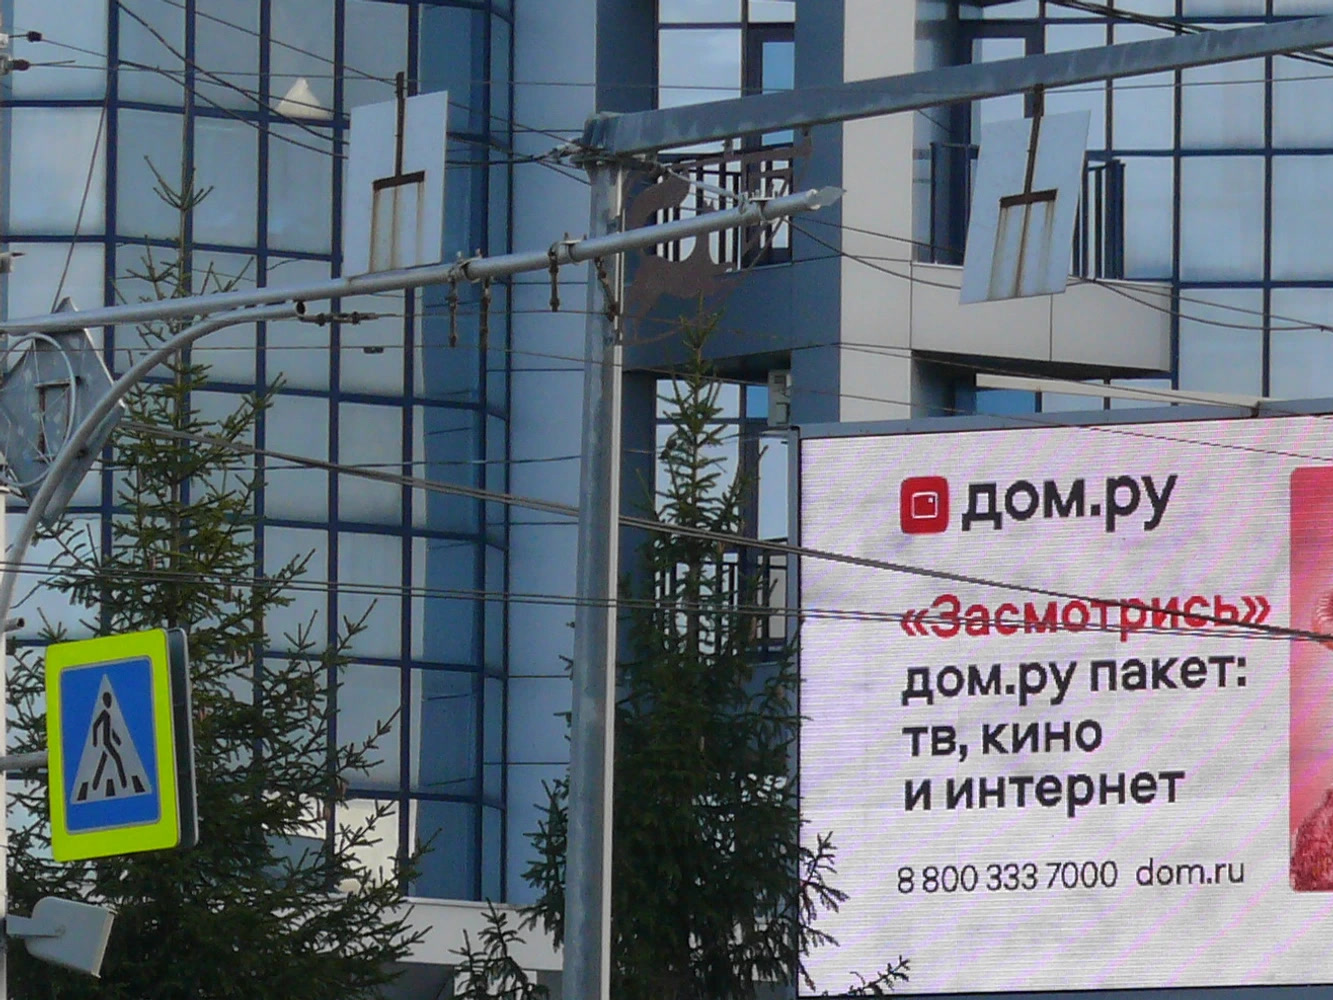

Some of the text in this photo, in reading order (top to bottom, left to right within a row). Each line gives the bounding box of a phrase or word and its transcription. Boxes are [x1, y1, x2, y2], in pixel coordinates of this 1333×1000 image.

[961, 474, 1177, 532] дом.ру
[900, 594, 1271, 642] «Засмотрись»
[901, 655, 1247, 706] дом.ру пакет:
[902, 719, 1102, 761] тв, кино
[904, 770, 1185, 817] и интернет
[897, 858, 1245, 894] 8 800 333 7000 dom.ru
